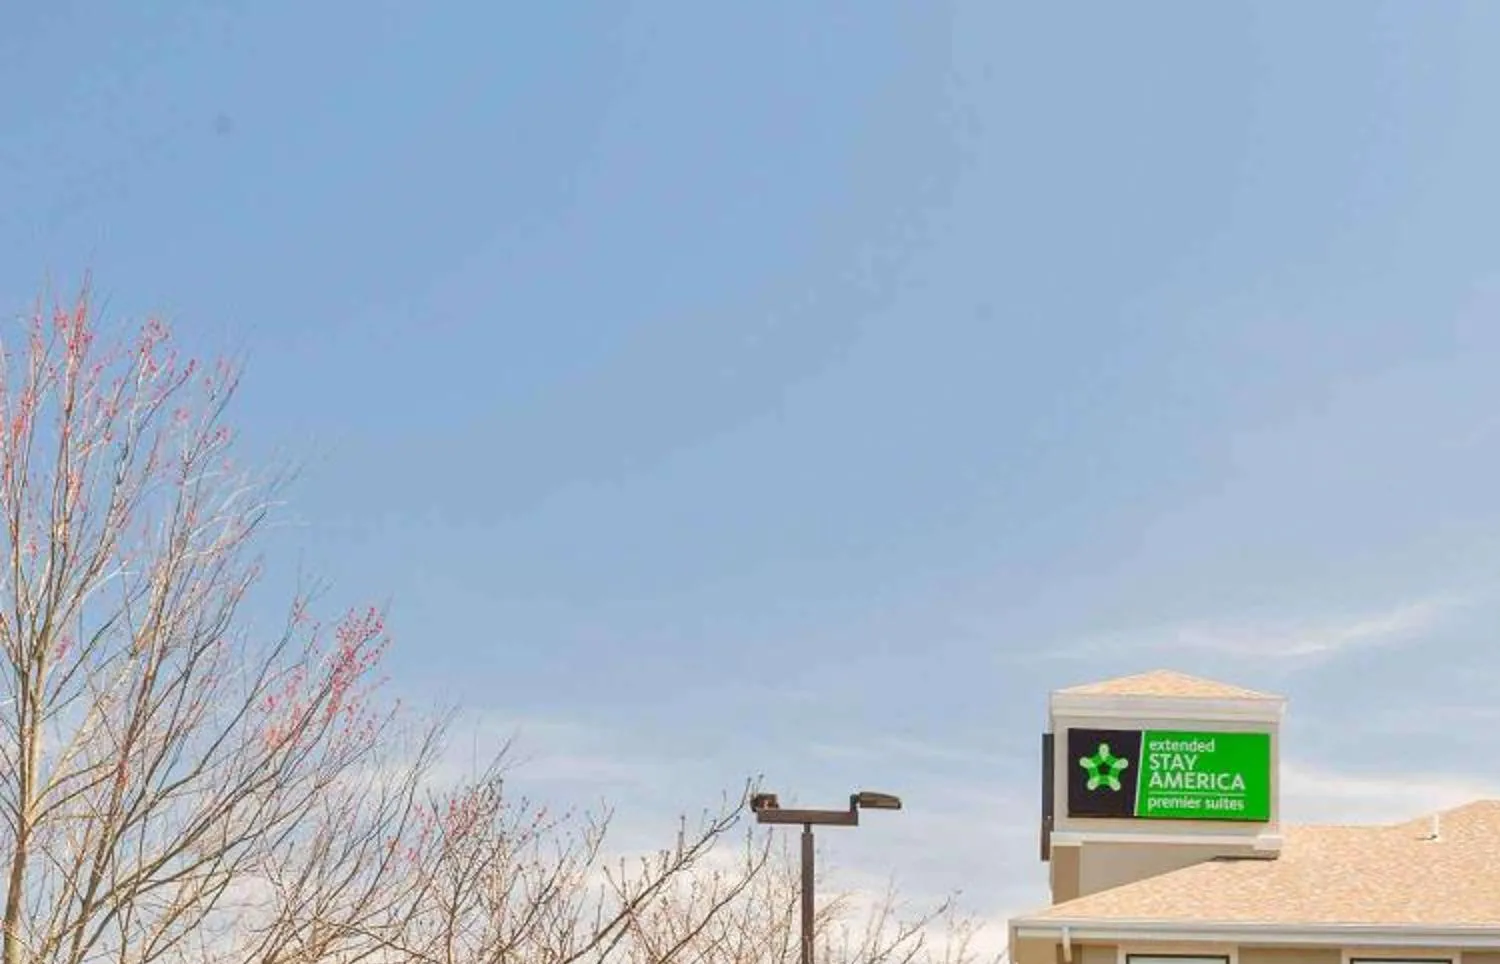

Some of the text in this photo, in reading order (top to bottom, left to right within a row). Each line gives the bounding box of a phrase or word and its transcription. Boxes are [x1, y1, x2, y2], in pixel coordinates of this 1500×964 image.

[1149, 738, 1216, 752] extended
[1149, 753, 1198, 771] STAY
[1149, 771, 1246, 790] AMERICA
[1148, 796, 1245, 811] premier suites
